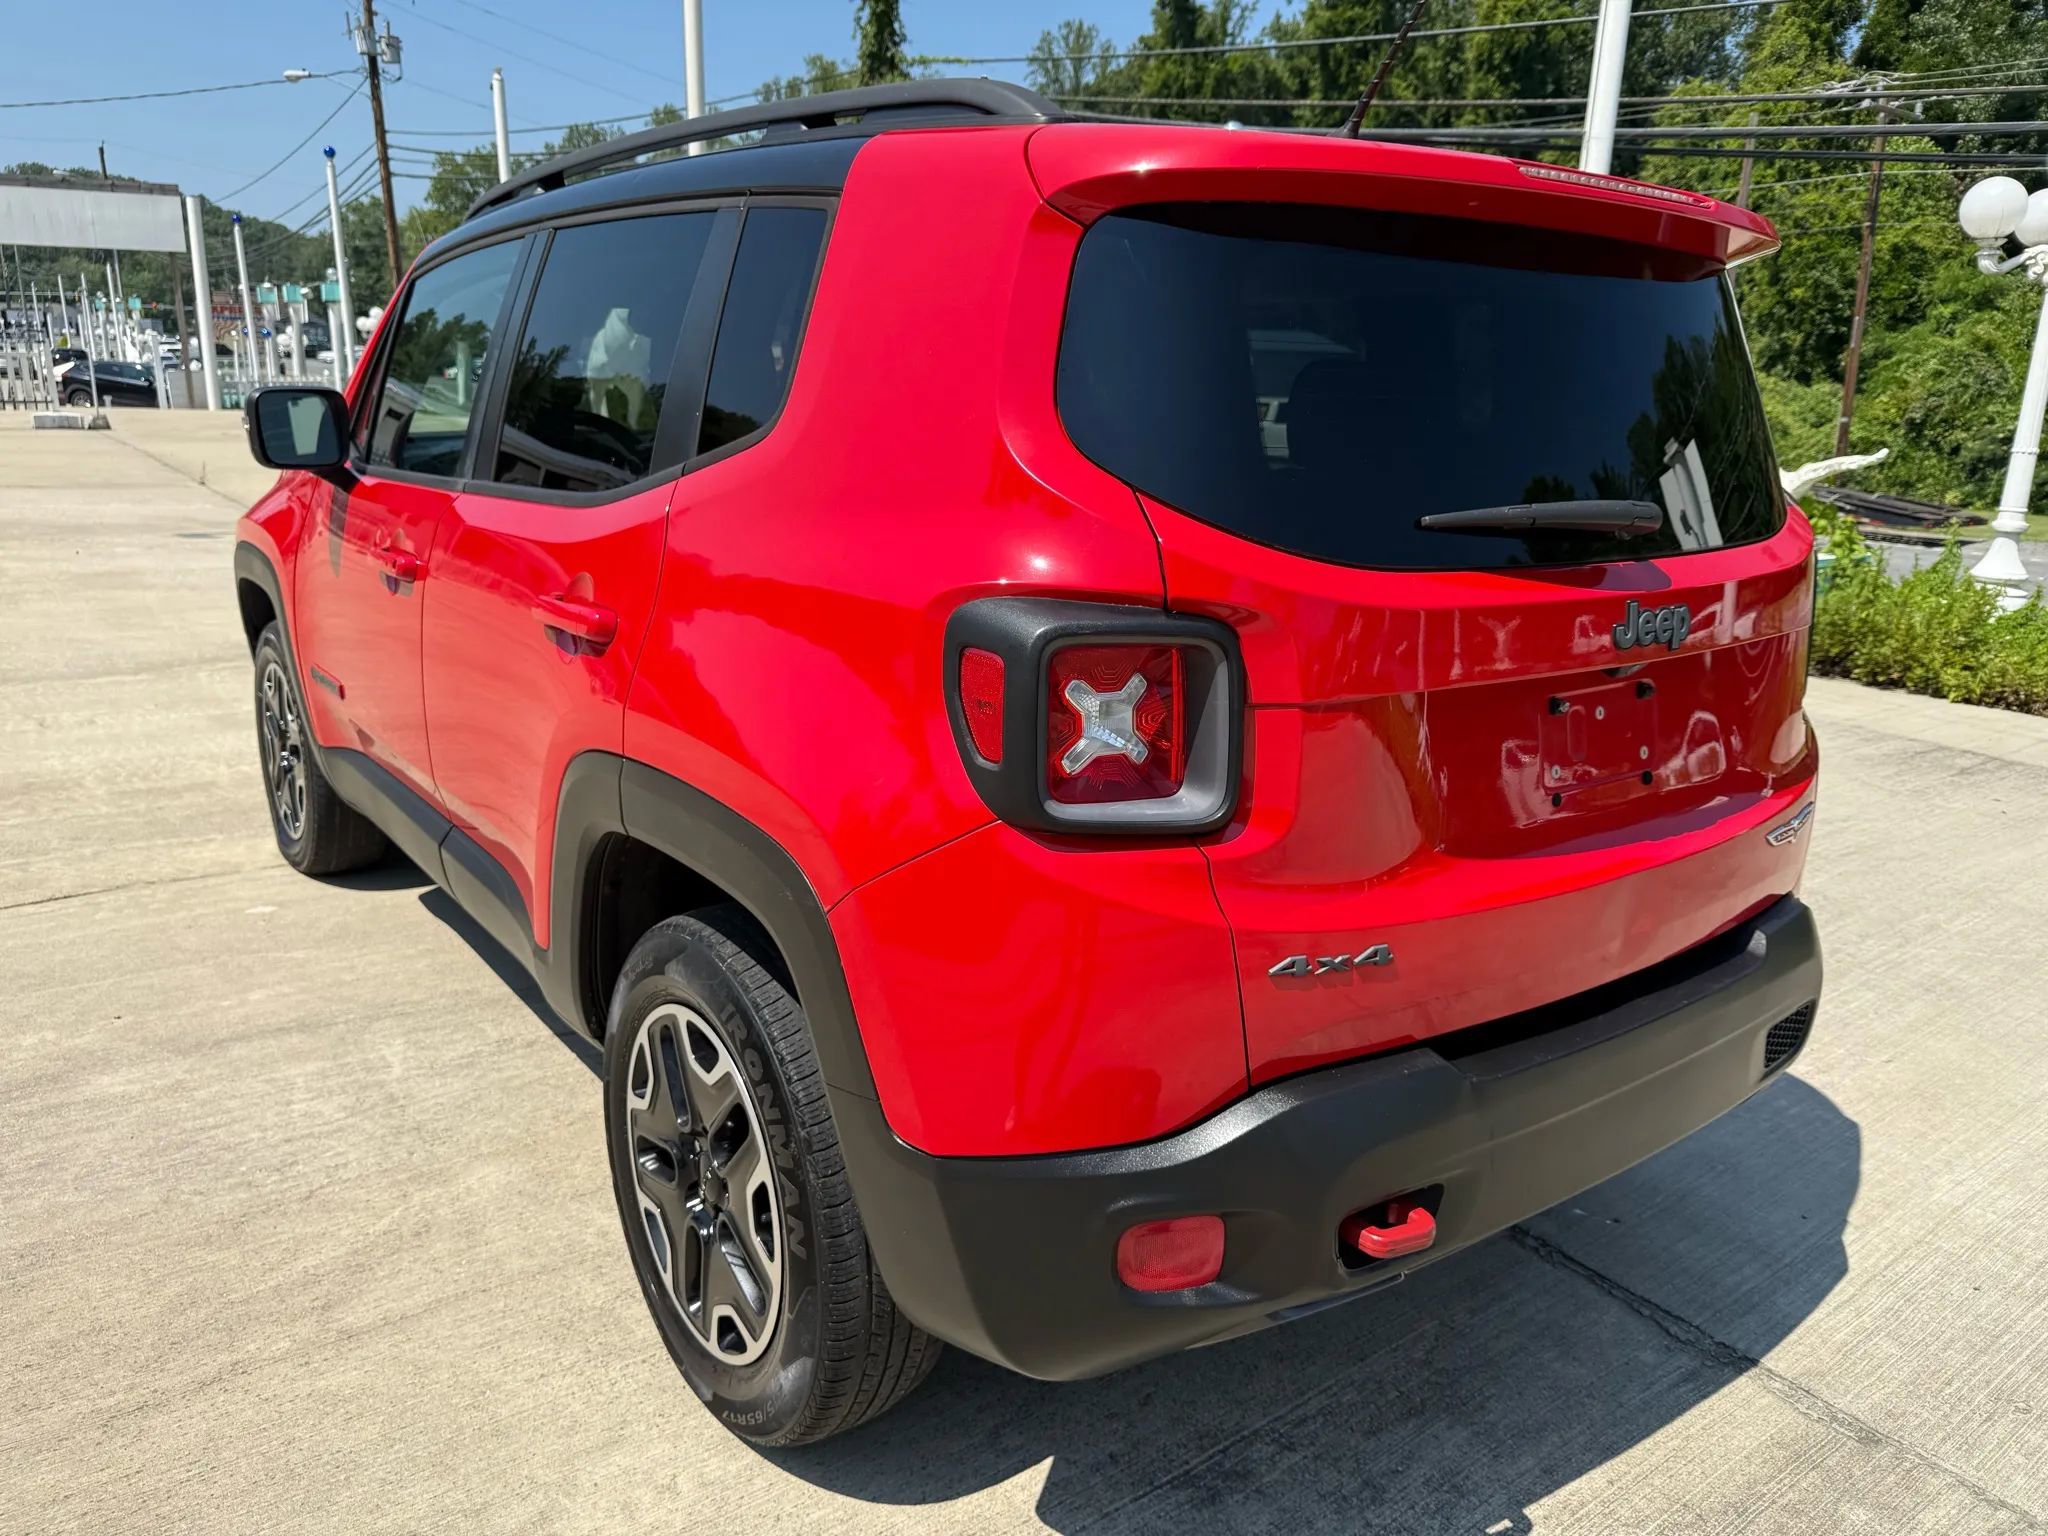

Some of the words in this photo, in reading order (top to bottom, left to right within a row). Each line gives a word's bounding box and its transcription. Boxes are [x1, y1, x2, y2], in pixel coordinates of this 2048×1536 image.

[1613, 600, 1690, 651] Jeep
[1268, 943, 1394, 977] 4x4
[720, 1002, 808, 1260] IRONMAN
